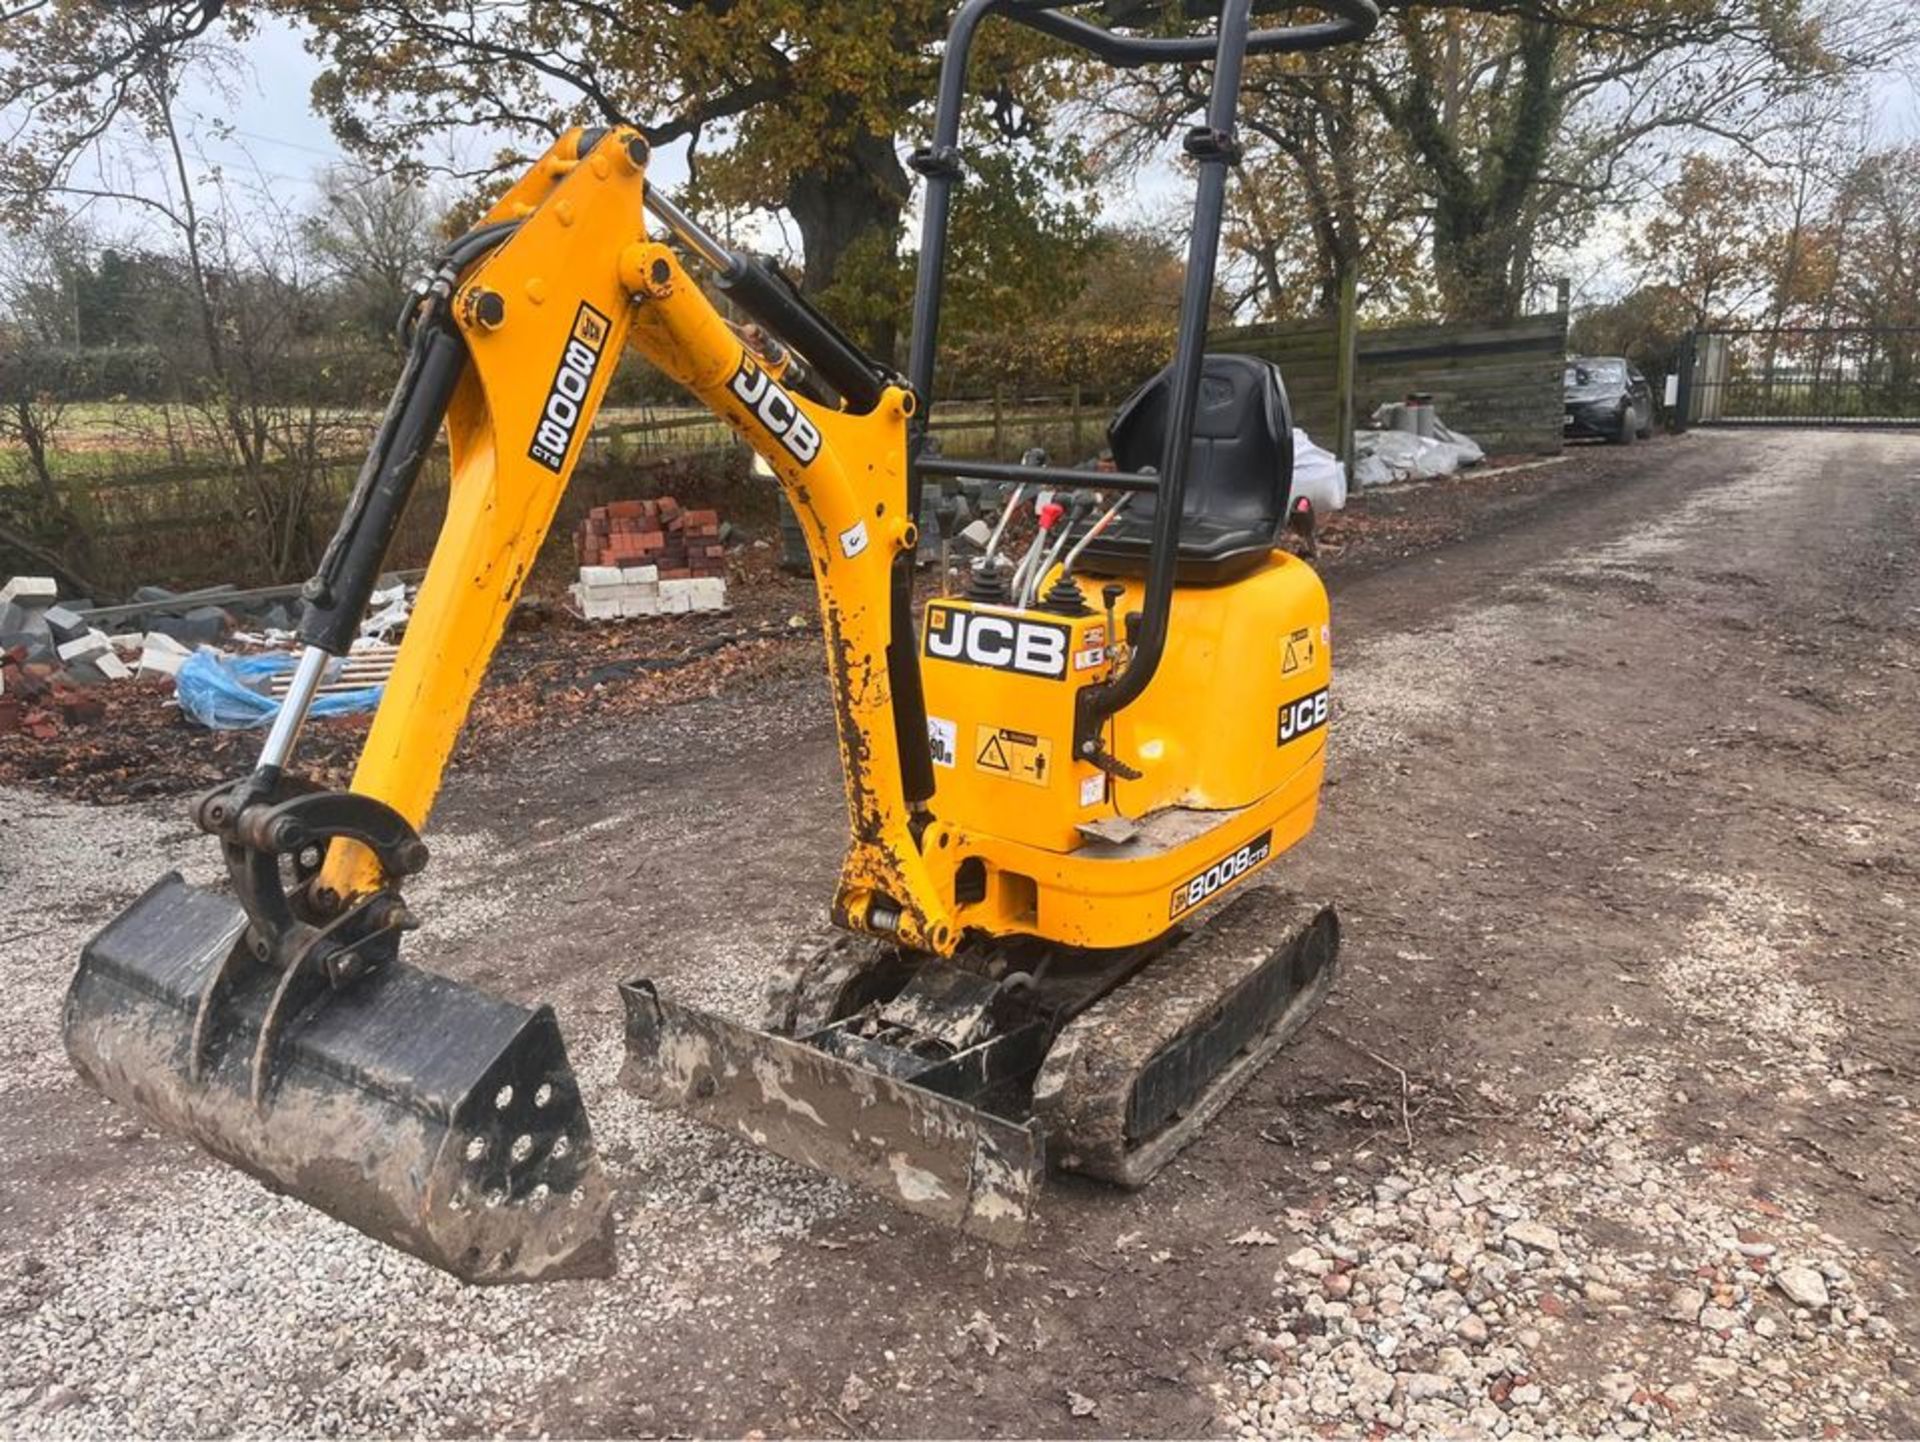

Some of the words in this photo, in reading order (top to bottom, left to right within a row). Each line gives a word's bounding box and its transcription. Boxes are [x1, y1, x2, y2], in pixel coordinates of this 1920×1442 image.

[537, 340, 596, 455] 8008
[734, 371, 820, 462] JCB
[928, 613, 1066, 675] JCB
[1280, 690, 1329, 740] JCB
[1188, 846, 1250, 906] 8008
